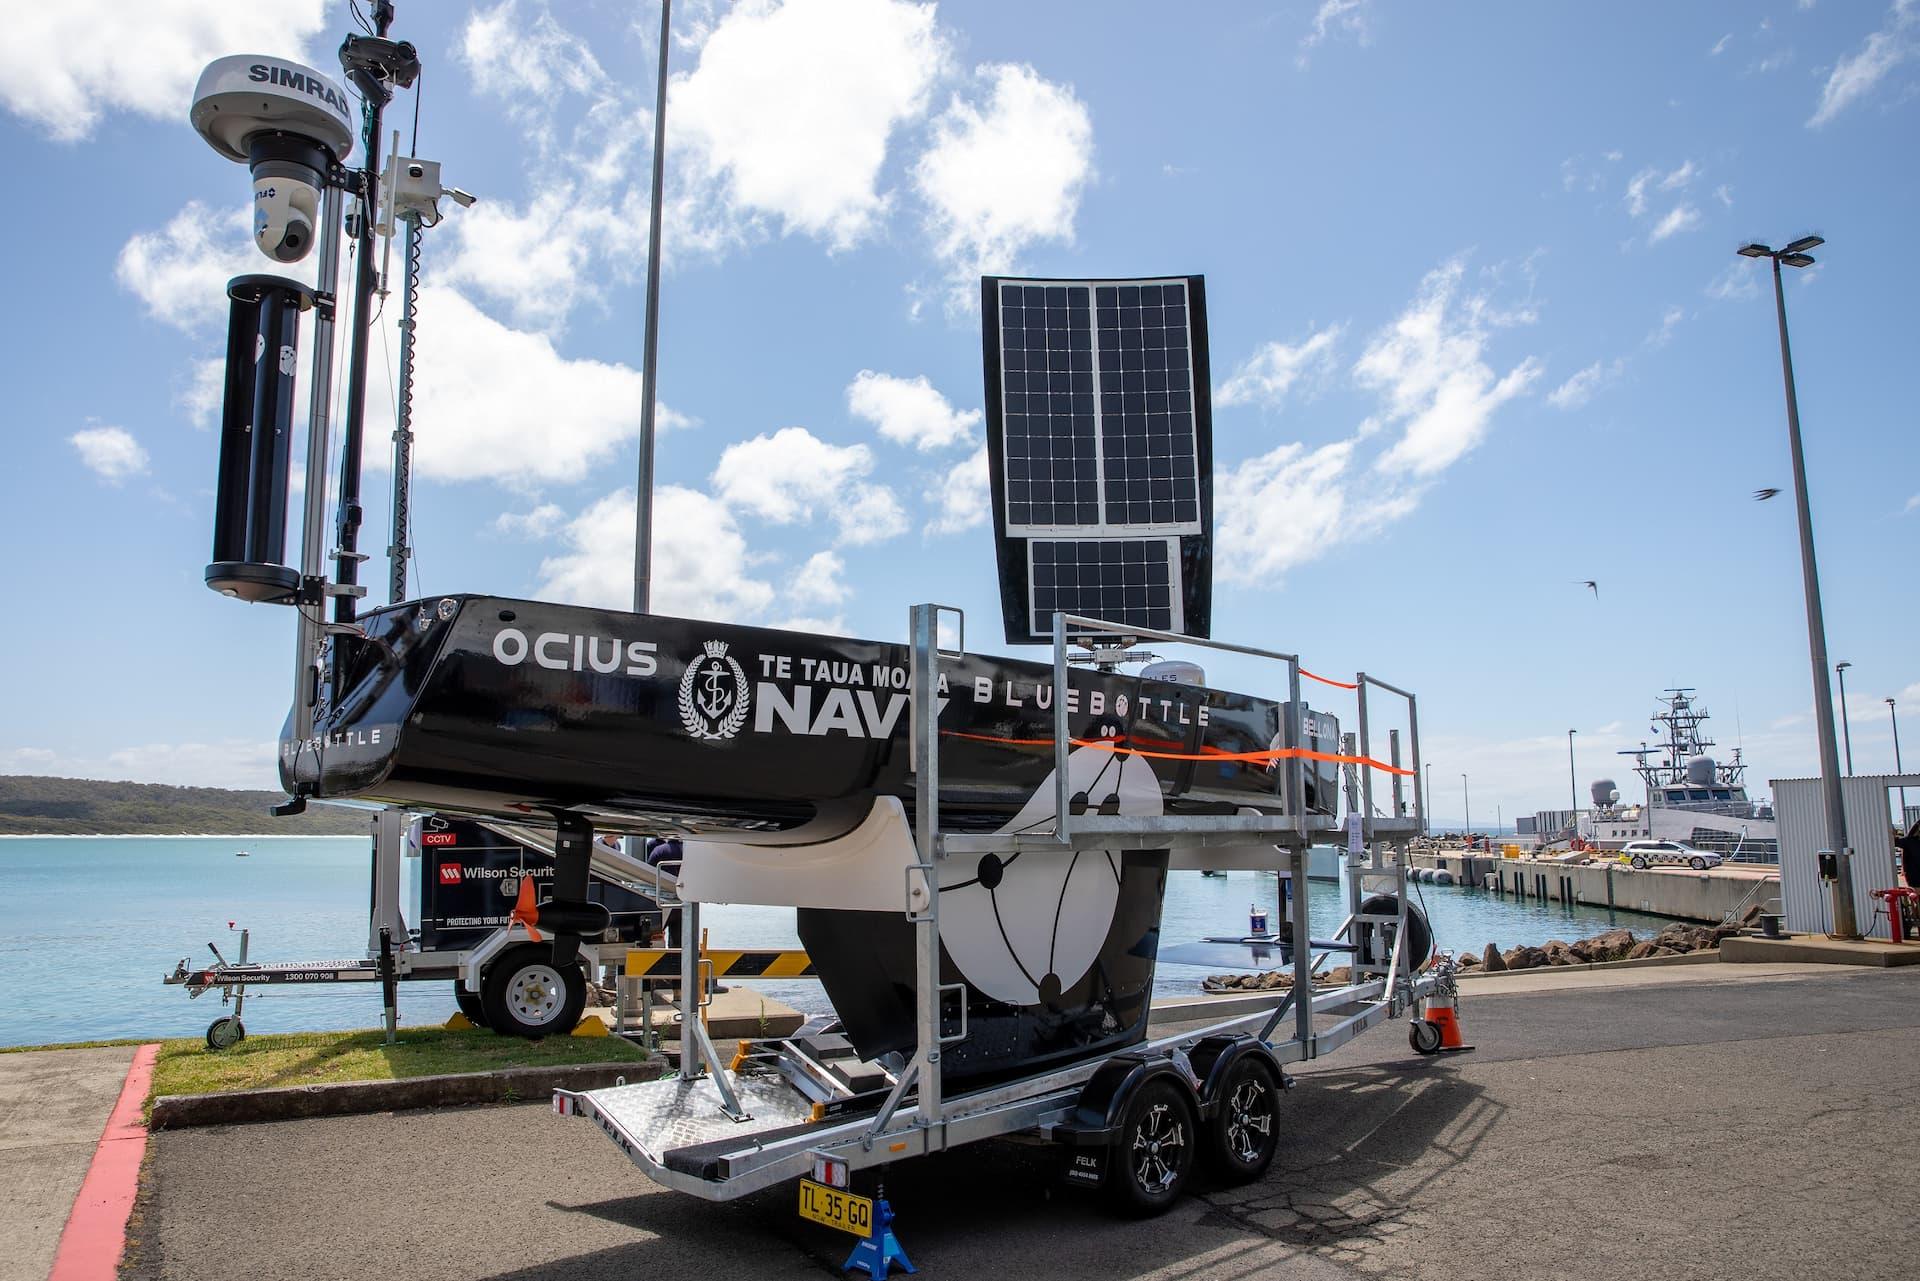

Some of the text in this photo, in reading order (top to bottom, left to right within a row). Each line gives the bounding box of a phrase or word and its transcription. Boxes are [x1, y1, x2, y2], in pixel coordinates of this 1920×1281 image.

[493, 628, 657, 676] OCIUS
[758, 653, 950, 694] TE TAUA MOA
[974, 676, 1209, 726] BLUEBOTTLE
[426, 835, 452, 844] CCTV
[463, 866, 555, 879] Wilson Securit
[446, 917, 482, 926] PROTECTING
[482, 917, 499, 926] YOUR
[241, 973, 270, 983] Security
[285, 973, 303, 981] 1300
[304, 973, 319, 981] 070
[593, 1109, 633, 1155] FELK
[1076, 1155, 1097, 1168] FELK
[802, 1185, 869, 1228] TL 35 GQ
